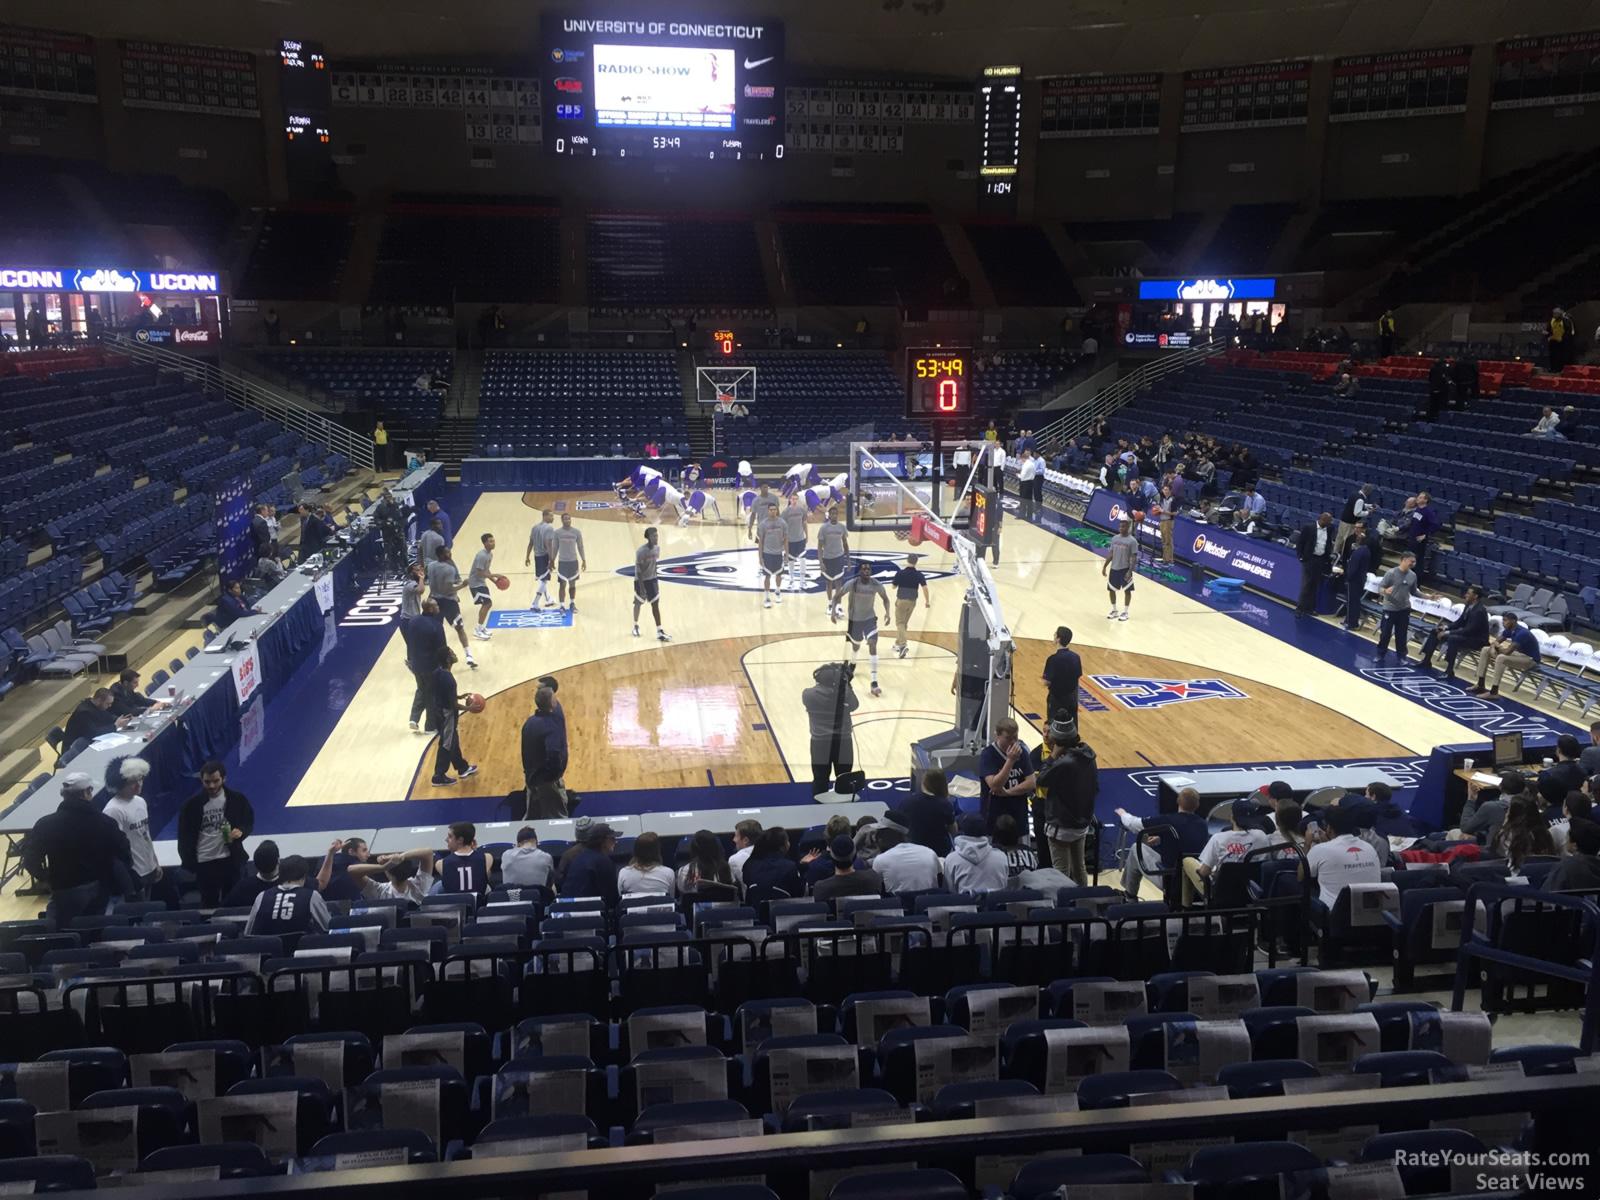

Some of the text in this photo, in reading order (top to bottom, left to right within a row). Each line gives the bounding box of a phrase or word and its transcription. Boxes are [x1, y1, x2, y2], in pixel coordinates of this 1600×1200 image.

[564, 20, 764, 39] UNIVERSITY OF CONNECTICUT
[598, 64, 691, 76] RADIO SHOW
[442, 91, 460, 102] 42
[468, 92, 486, 103] 44
[557, 104, 581, 114] CBS
[556, 138, 564, 152] 0
[654, 137, 680, 148] 53:49
[776, 144, 784, 158] 0
[988, 183, 1011, 194] 11:04
[0, 270, 62, 288] CONN
[150, 274, 216, 290] UCONN
[714, 332, 734, 340] 53:49
[724, 340, 732, 353] 0
[916, 360, 962, 378] 53:49
[940, 380, 956, 410] 0
[1228, 844, 1246, 854] AAA
[458, 866, 472, 891] 11
[272, 893, 296, 920] 15
